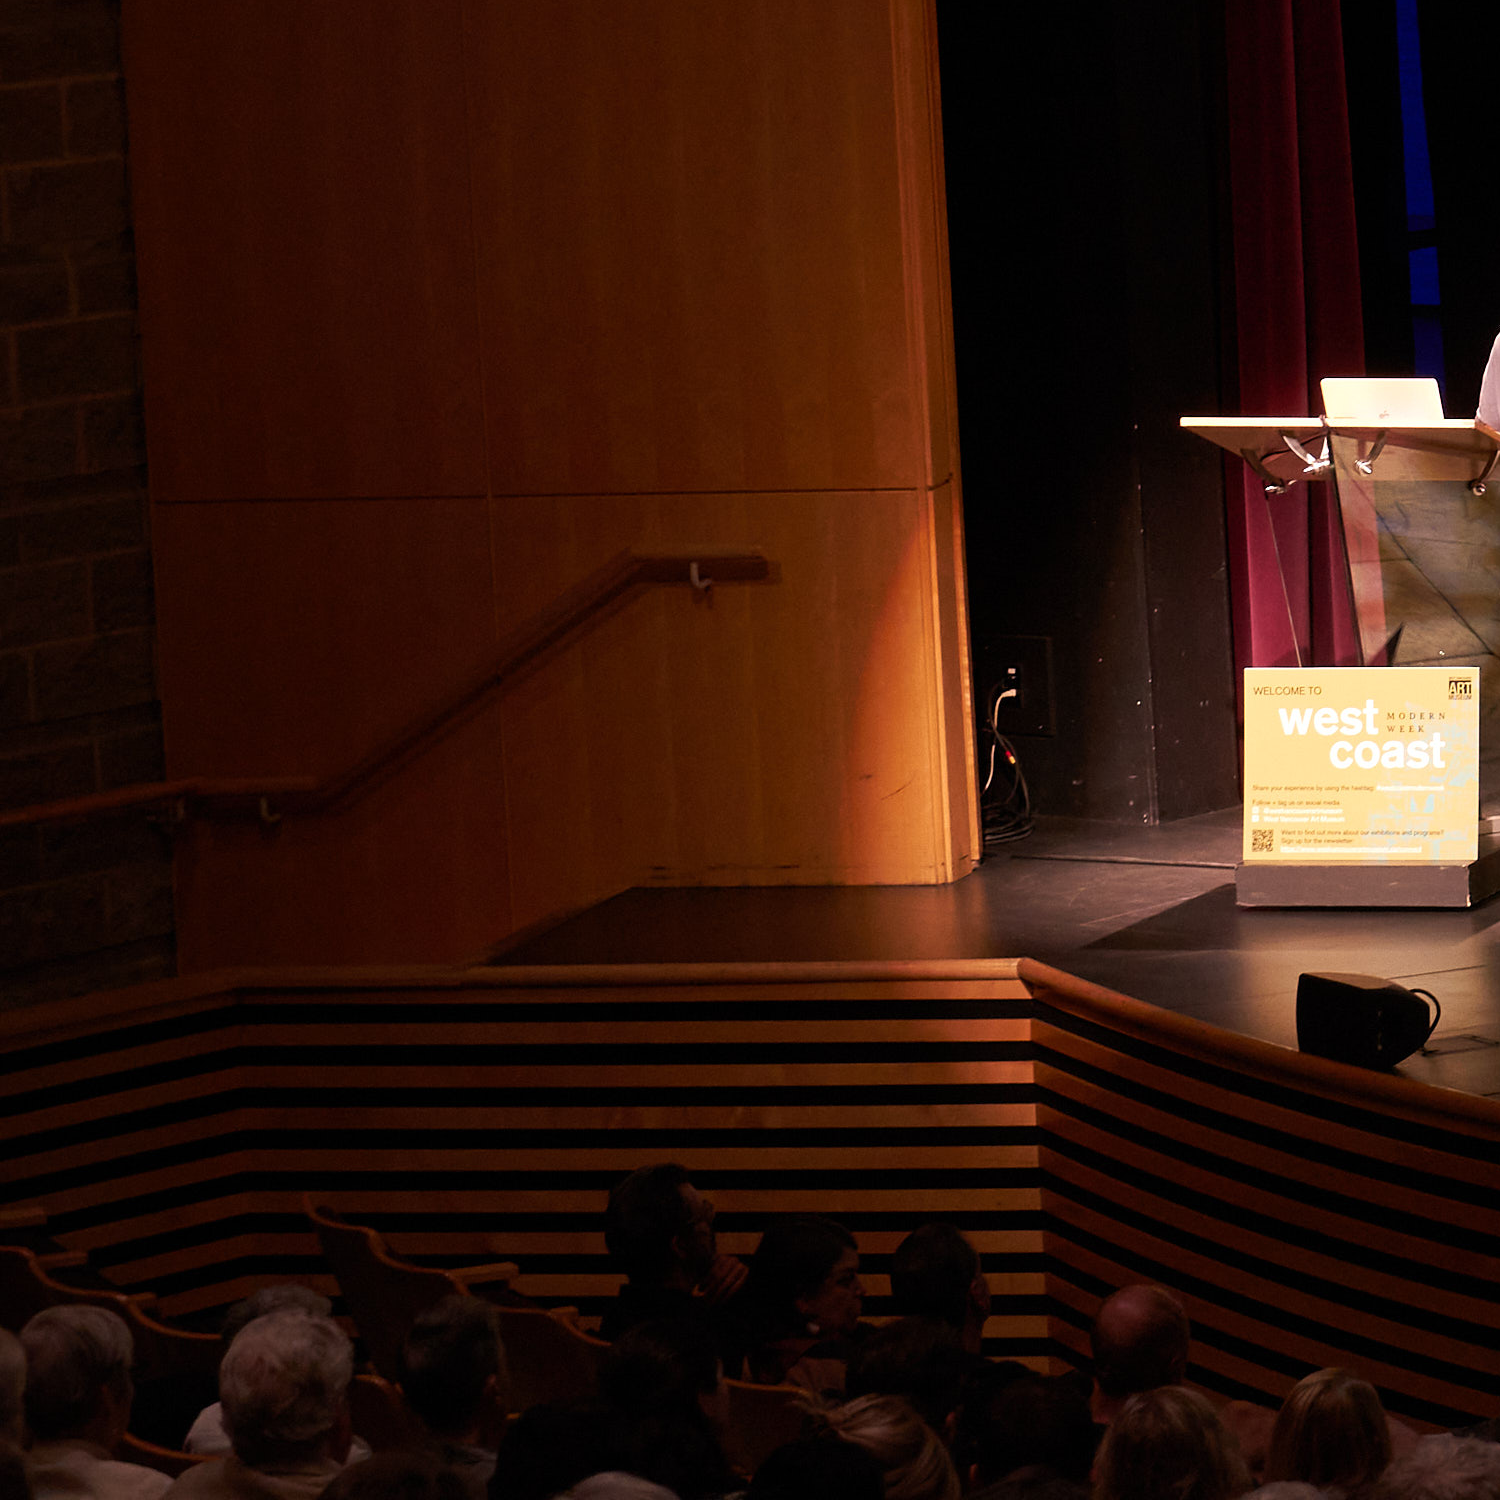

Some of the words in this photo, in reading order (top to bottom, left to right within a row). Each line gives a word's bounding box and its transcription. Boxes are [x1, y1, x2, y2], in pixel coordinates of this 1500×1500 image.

[1253, 686, 1305, 696] WELCOME
[1308, 686, 1322, 696] TO
[1449, 681, 1472, 695] ART
[1278, 699, 1379, 736] west
[1387, 712, 1446, 721] MODERN
[1387, 725, 1425, 733] WEEK
[1329, 732, 1446, 769] coast
